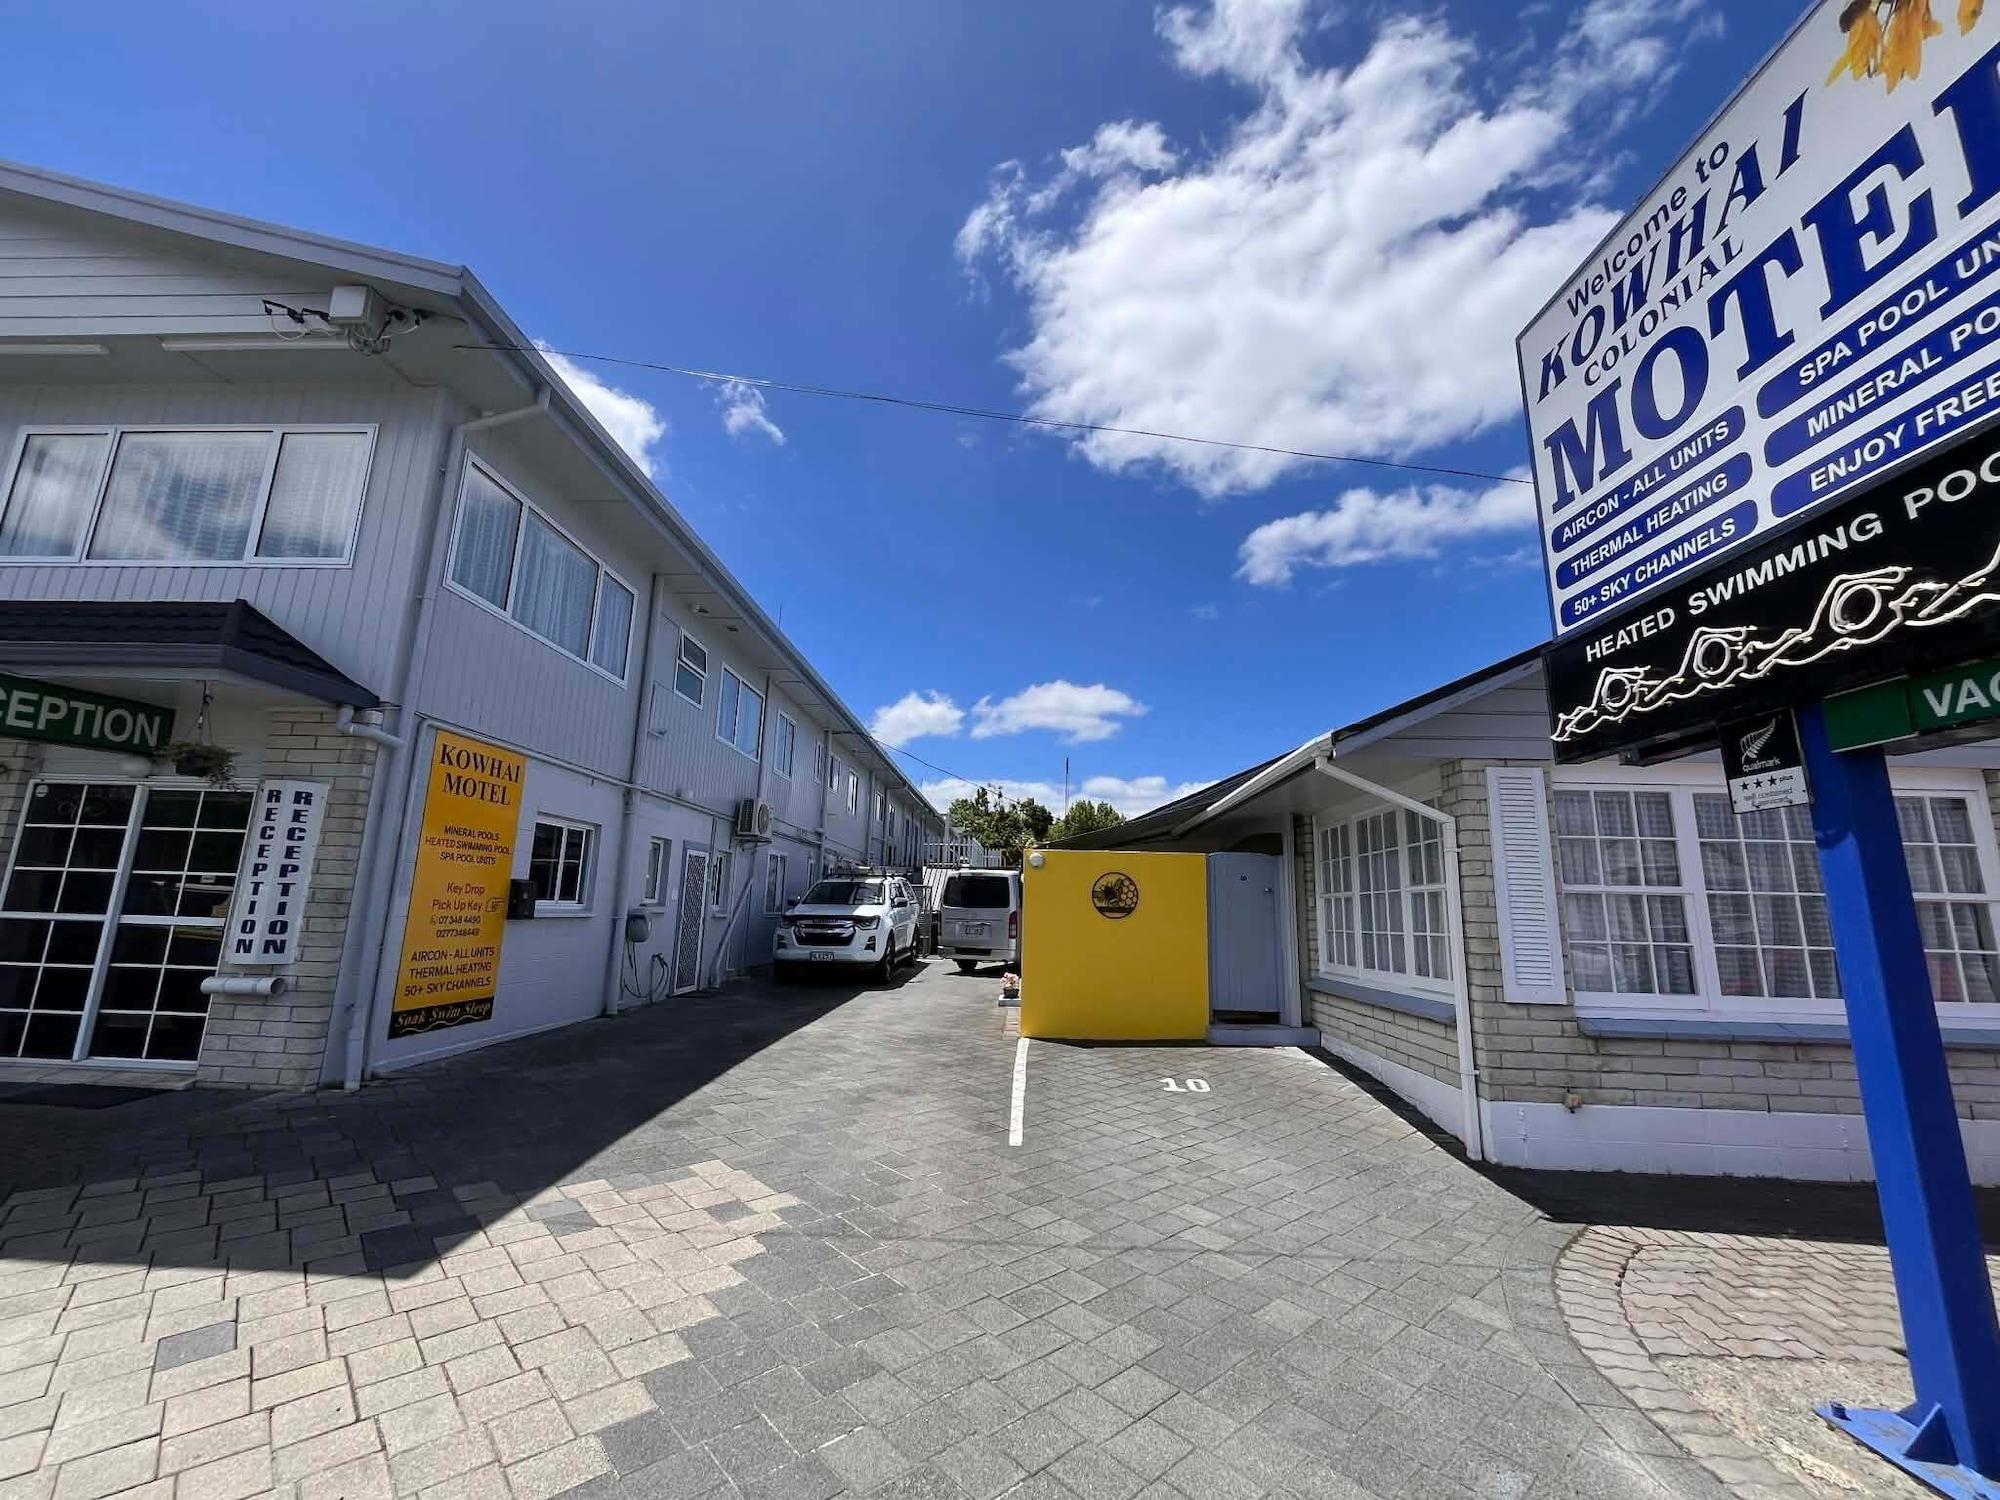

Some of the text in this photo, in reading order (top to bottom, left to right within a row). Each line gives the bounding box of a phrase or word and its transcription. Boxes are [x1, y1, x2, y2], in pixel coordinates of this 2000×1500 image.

[1537, 88, 1809, 403] KOWHAI
[1565, 141, 1729, 319] Welcome to
[1584, 238, 1744, 387] COLONIAL
[1799, 341, 1852, 386] SPA
[1857, 280, 1949, 347] POOL
[1806, 348, 1943, 438] MINERAL
[1561, 493, 1619, 542] AIRCON
[1632, 467, 1667, 498] ALL
[1670, 420, 1729, 472] UNITS
[1810, 423, 1906, 492] ENJOY
[1571, 472, 1728, 577] THERMAL HEATING
[1573, 518, 1736, 616] 50+ SKY CHANNELS
[1585, 606, 1675, 663] HEATED
[1688, 512, 1884, 616] SWIMMING
[440, 744, 520, 783] KOWHAI
[443, 772, 511, 806] MOTEL
[425, 836, 456, 848] HEATED
[456, 841, 493, 852] SWIMMING
[440, 852, 496, 865] SPA POOL UNITS
[444, 825, 499, 841] MINERAL POOLS
[234, 789, 282, 954] RECEPTION
[262, 789, 313, 954] RECEPTION
[432, 899, 482, 912] Pick Up Key
[447, 883, 485, 896] Key Drop
[404, 977, 492, 997] 50+ SKY CHANNELS
[410, 962, 491, 979] THERMAL HEATING
[411, 950, 448, 962] AIRCON
[453, 948, 469, 958] ALL
[470, 946, 495, 958] UNITS
[1160, 1077, 1211, 1092] 10
